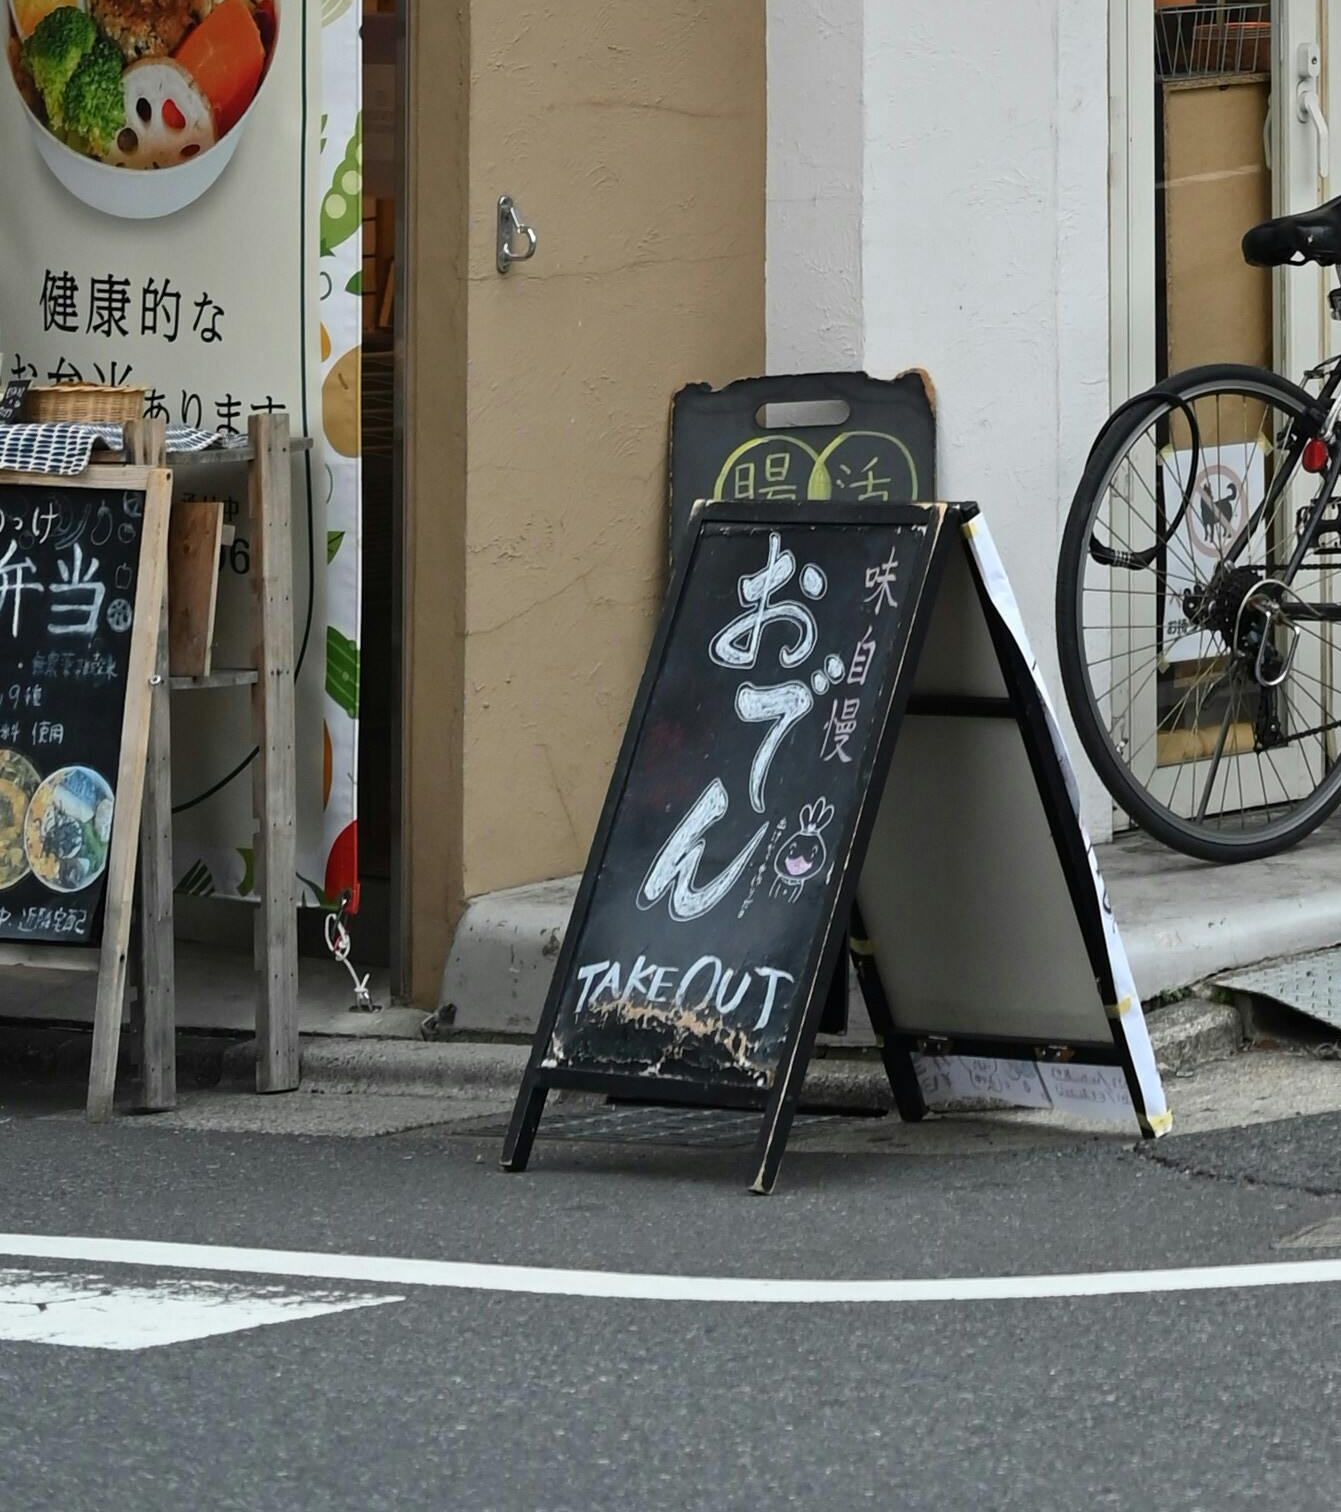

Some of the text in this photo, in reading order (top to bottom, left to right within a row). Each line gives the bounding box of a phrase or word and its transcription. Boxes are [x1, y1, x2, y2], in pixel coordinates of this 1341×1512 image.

[40, 269, 225, 343] 健康的な
[635, 530, 847, 921] おでん
[821, 545, 902, 764] 味自慢
